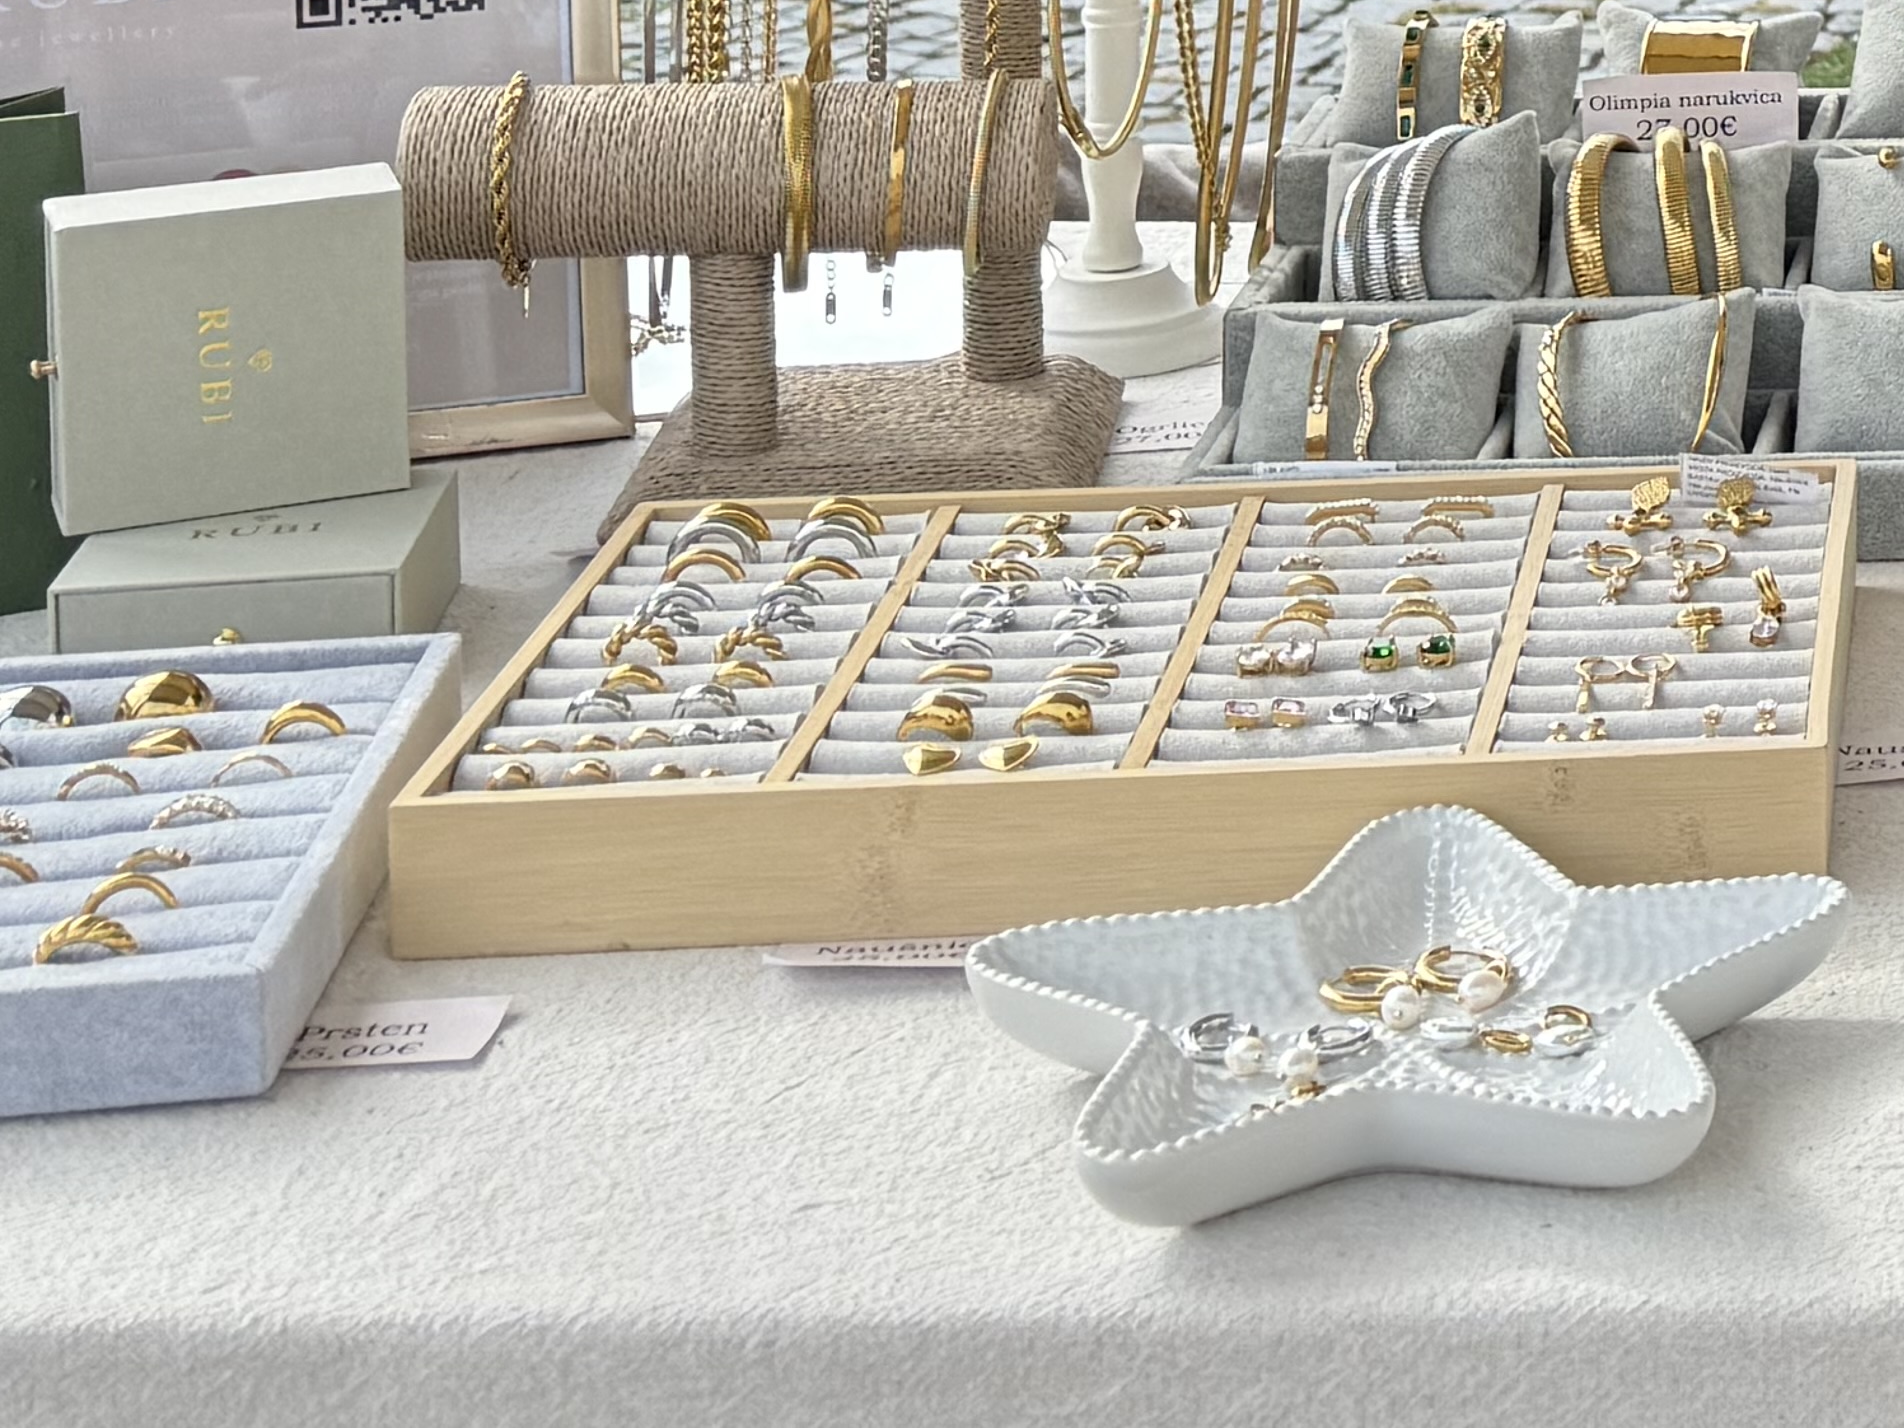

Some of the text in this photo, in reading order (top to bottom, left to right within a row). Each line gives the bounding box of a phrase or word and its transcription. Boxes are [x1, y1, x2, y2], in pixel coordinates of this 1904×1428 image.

[1589, 89, 1783, 115] Olimpia narukvica
[1636, 116, 1738, 141] 200€
[197, 307, 233, 424] RUBI
[190, 521, 322, 540] RUBI
[299, 1021, 429, 1042] Prsten
